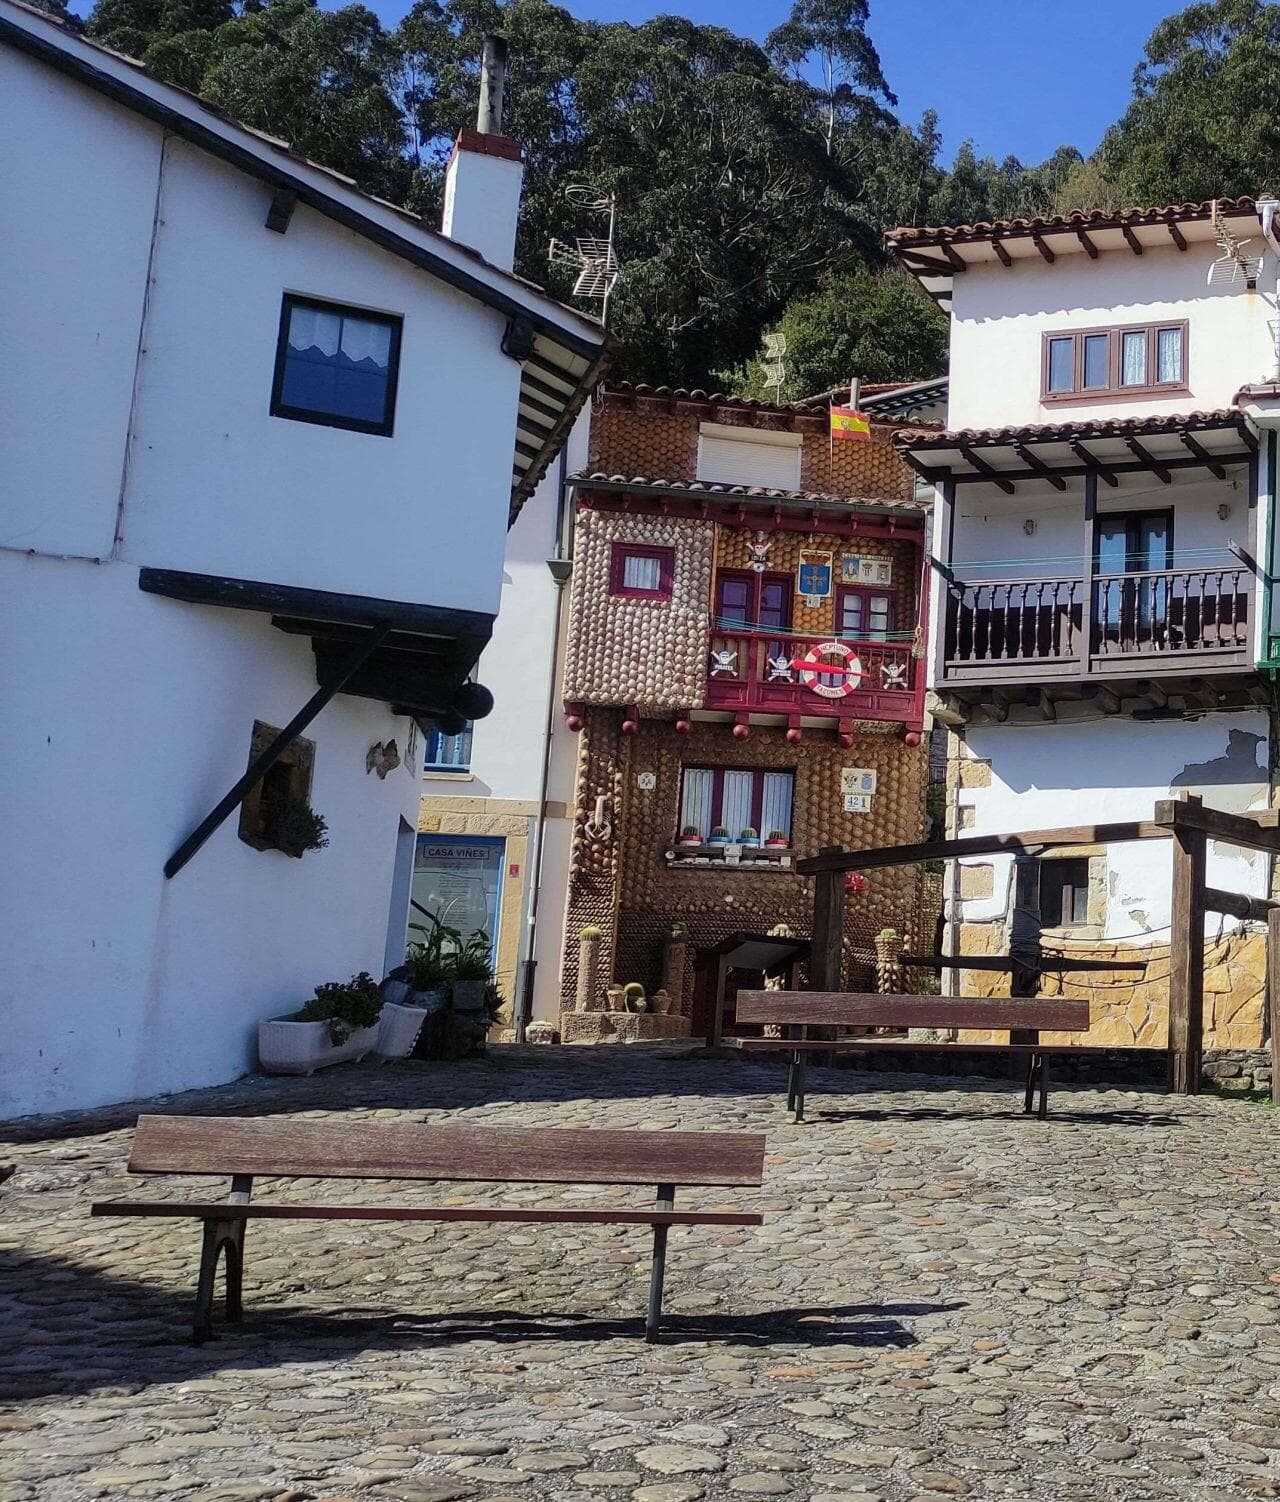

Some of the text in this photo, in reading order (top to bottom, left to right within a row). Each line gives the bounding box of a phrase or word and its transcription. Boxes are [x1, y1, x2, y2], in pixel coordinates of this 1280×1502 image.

[820, 644, 849, 654] NEPTUNO
[816, 685, 845, 696] TAZONES
[847, 796, 859, 806] 42
[428, 847, 485, 858] CASA VIÑES
